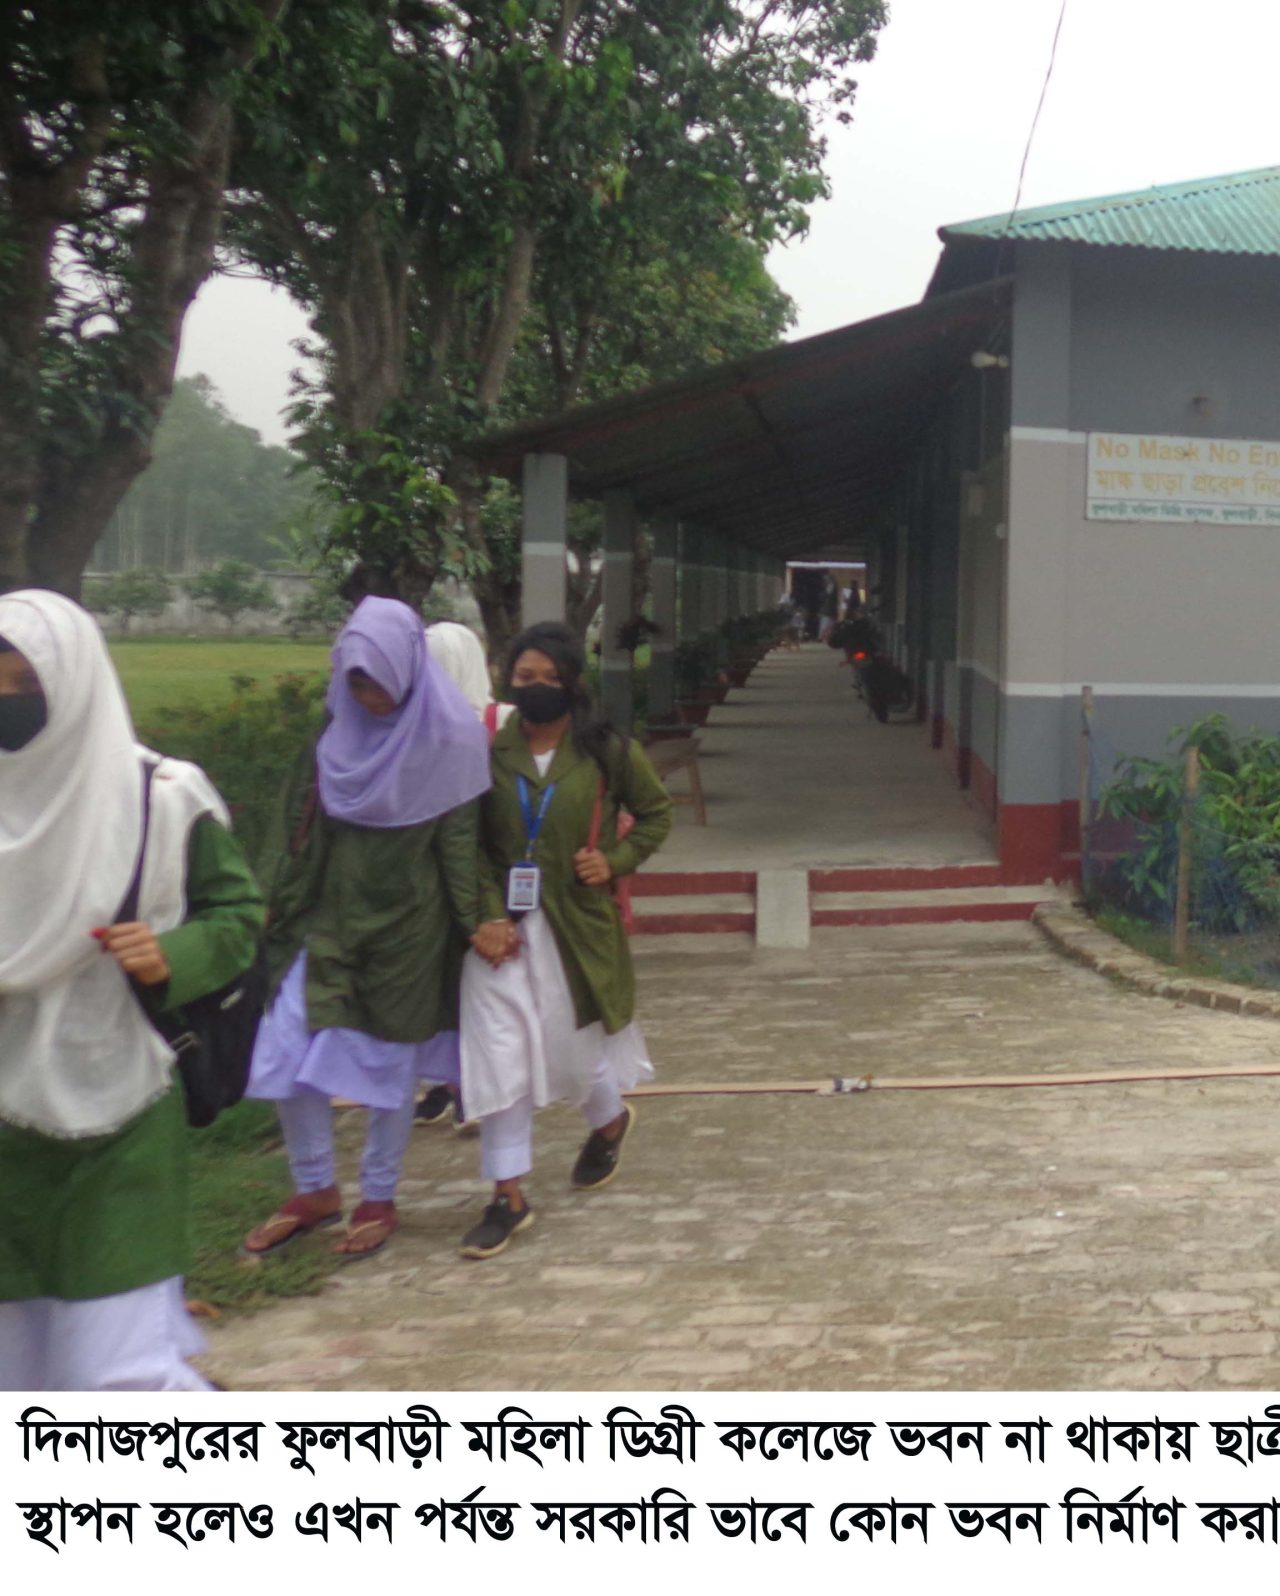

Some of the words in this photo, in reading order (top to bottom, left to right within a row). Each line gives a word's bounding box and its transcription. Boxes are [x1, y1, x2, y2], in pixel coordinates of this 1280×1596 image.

[1096, 437, 1130, 459] No
[1138, 438, 1200, 462] Mask
[1209, 442, 1241, 464] No
[1192, 473, 1247, 496] প্রবেশ
